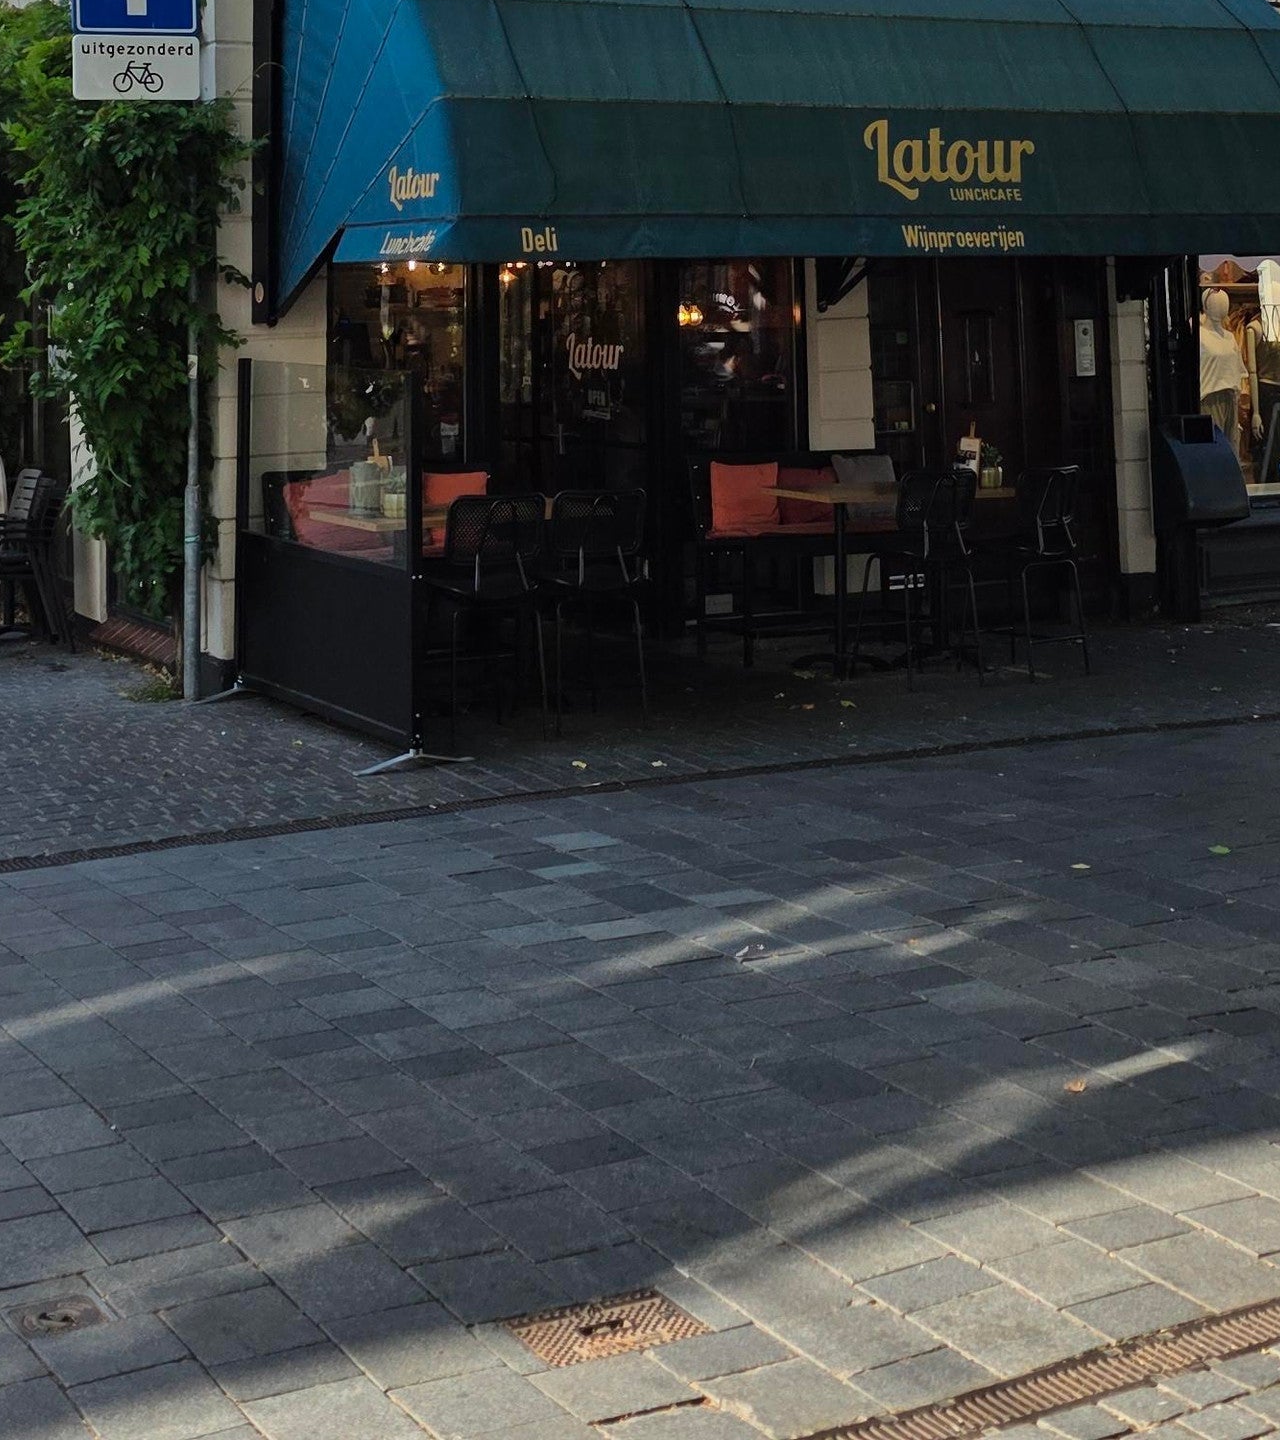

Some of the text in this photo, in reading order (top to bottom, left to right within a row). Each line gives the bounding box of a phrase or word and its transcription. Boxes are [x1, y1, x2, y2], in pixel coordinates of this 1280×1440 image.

[80, 42, 194, 58] uitgezonderd
[863, 119, 1036, 201] Latour
[388, 165, 440, 212] Latour
[949, 187, 1023, 202] LUNCHCAFE
[521, 226, 559, 253] Deli
[901, 224, 1025, 252] Wijnproeverijen
[565, 332, 625, 380] Latour
